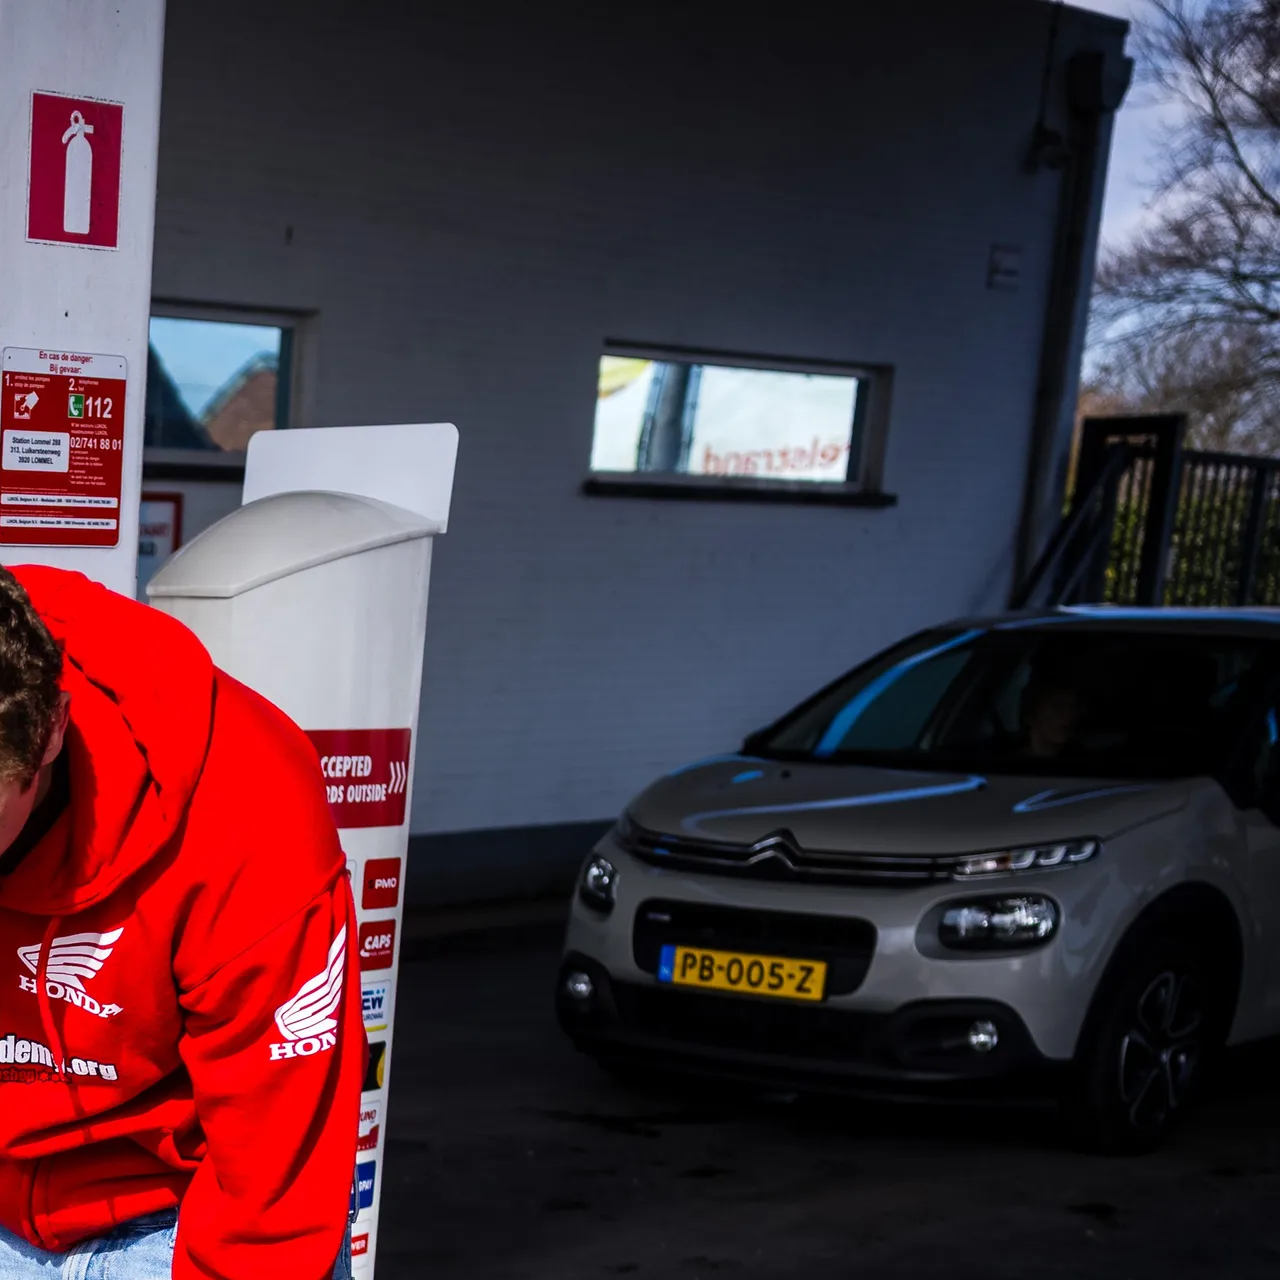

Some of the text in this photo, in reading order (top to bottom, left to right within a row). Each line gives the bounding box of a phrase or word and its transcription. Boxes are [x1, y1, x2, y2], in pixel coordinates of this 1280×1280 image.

[39, 351, 93, 364] En cas de danger:
[49, 364, 82, 374] Bij gevaar:
[85, 397, 113, 419] 112
[12, 437, 31, 445] Station
[31, 437, 51, 446] Lommel
[70, 437, 122, 450] 02/741 88 01
[31, 457, 54, 465] LOMMEL
[321, 755, 372, 778] CCEPTED
[326, 783, 387, 804] RDS OUTSIDE
[375, 877, 397, 890] PMO
[364, 934, 391, 950] CAPS
[680, 952, 815, 994] PB-005-Z
[362, 1011, 384, 1021] UROWAG
[269, 1029, 338, 1060] HON
